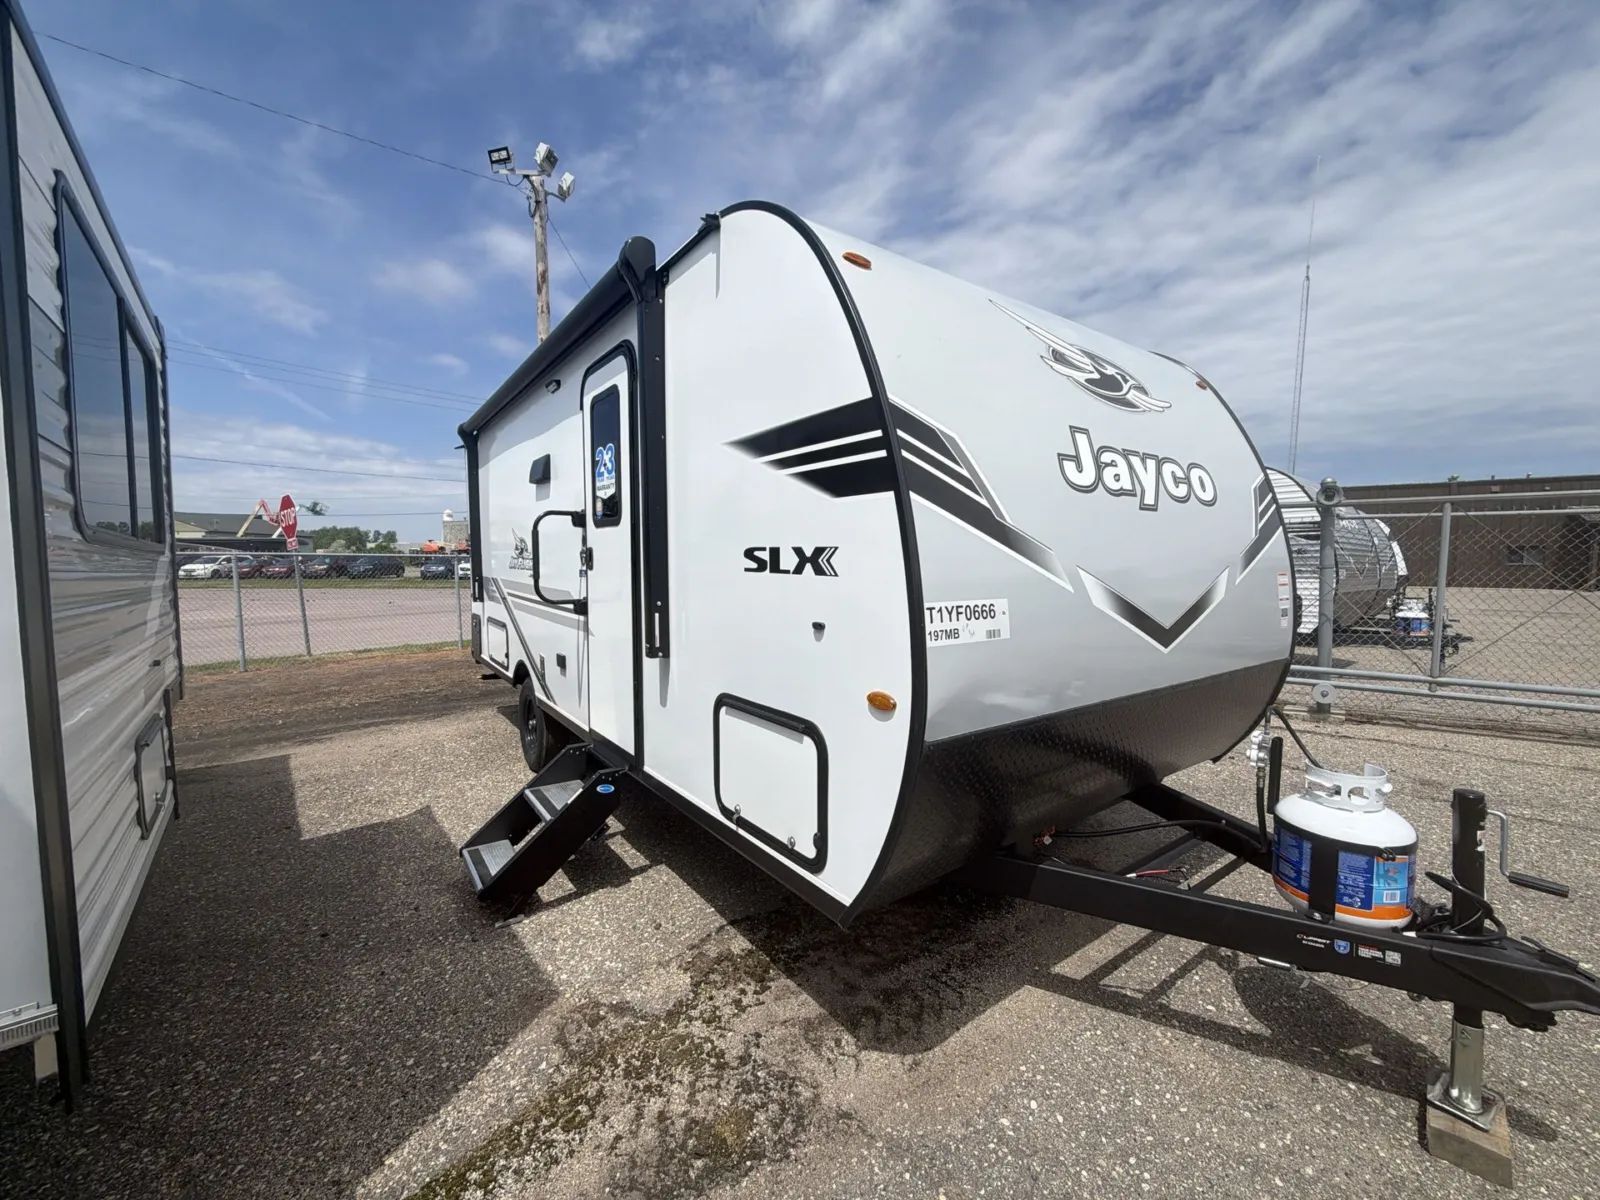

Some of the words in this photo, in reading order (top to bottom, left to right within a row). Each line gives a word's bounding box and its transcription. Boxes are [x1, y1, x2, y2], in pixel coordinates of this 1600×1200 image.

[1057, 425, 1217, 511] Jayco
[280, 507, 296, 528] STOP
[743, 546, 839, 577] SLX
[926, 603, 996, 624] T1YF0666
[928, 628, 960, 642] 197MB
